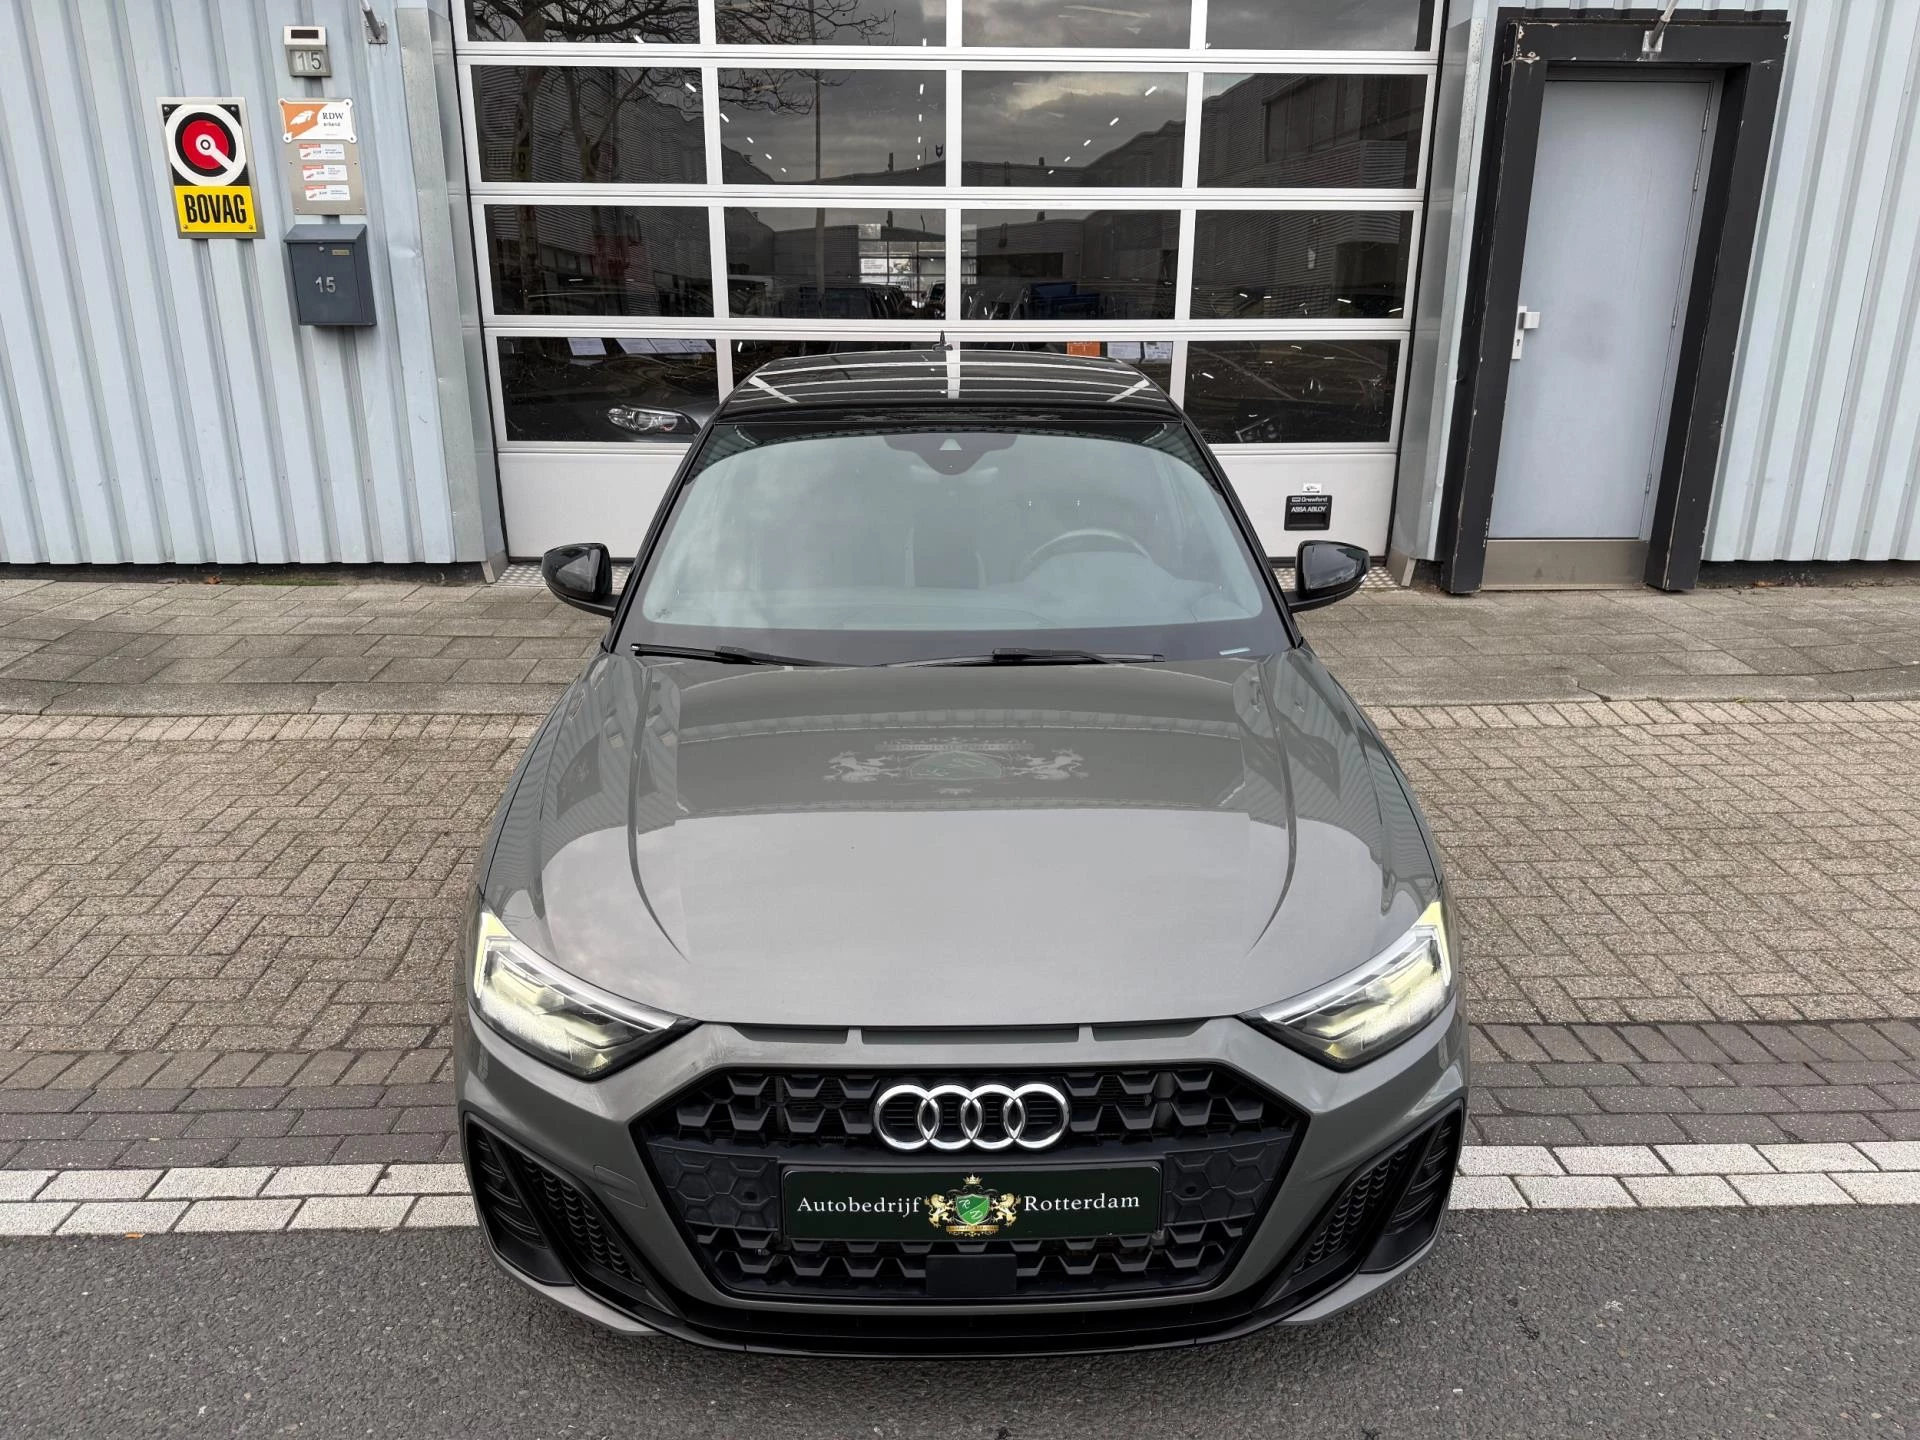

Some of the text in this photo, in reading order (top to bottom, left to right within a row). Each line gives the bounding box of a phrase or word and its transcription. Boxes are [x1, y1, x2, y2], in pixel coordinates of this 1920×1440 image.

[297, 52, 321, 70] 15
[322, 112, 344, 120] RDW
[184, 194, 247, 224] BOVAG
[315, 276, 336, 293] 15
[797, 1192, 1140, 1218] Autobedrijf Rotterdam
